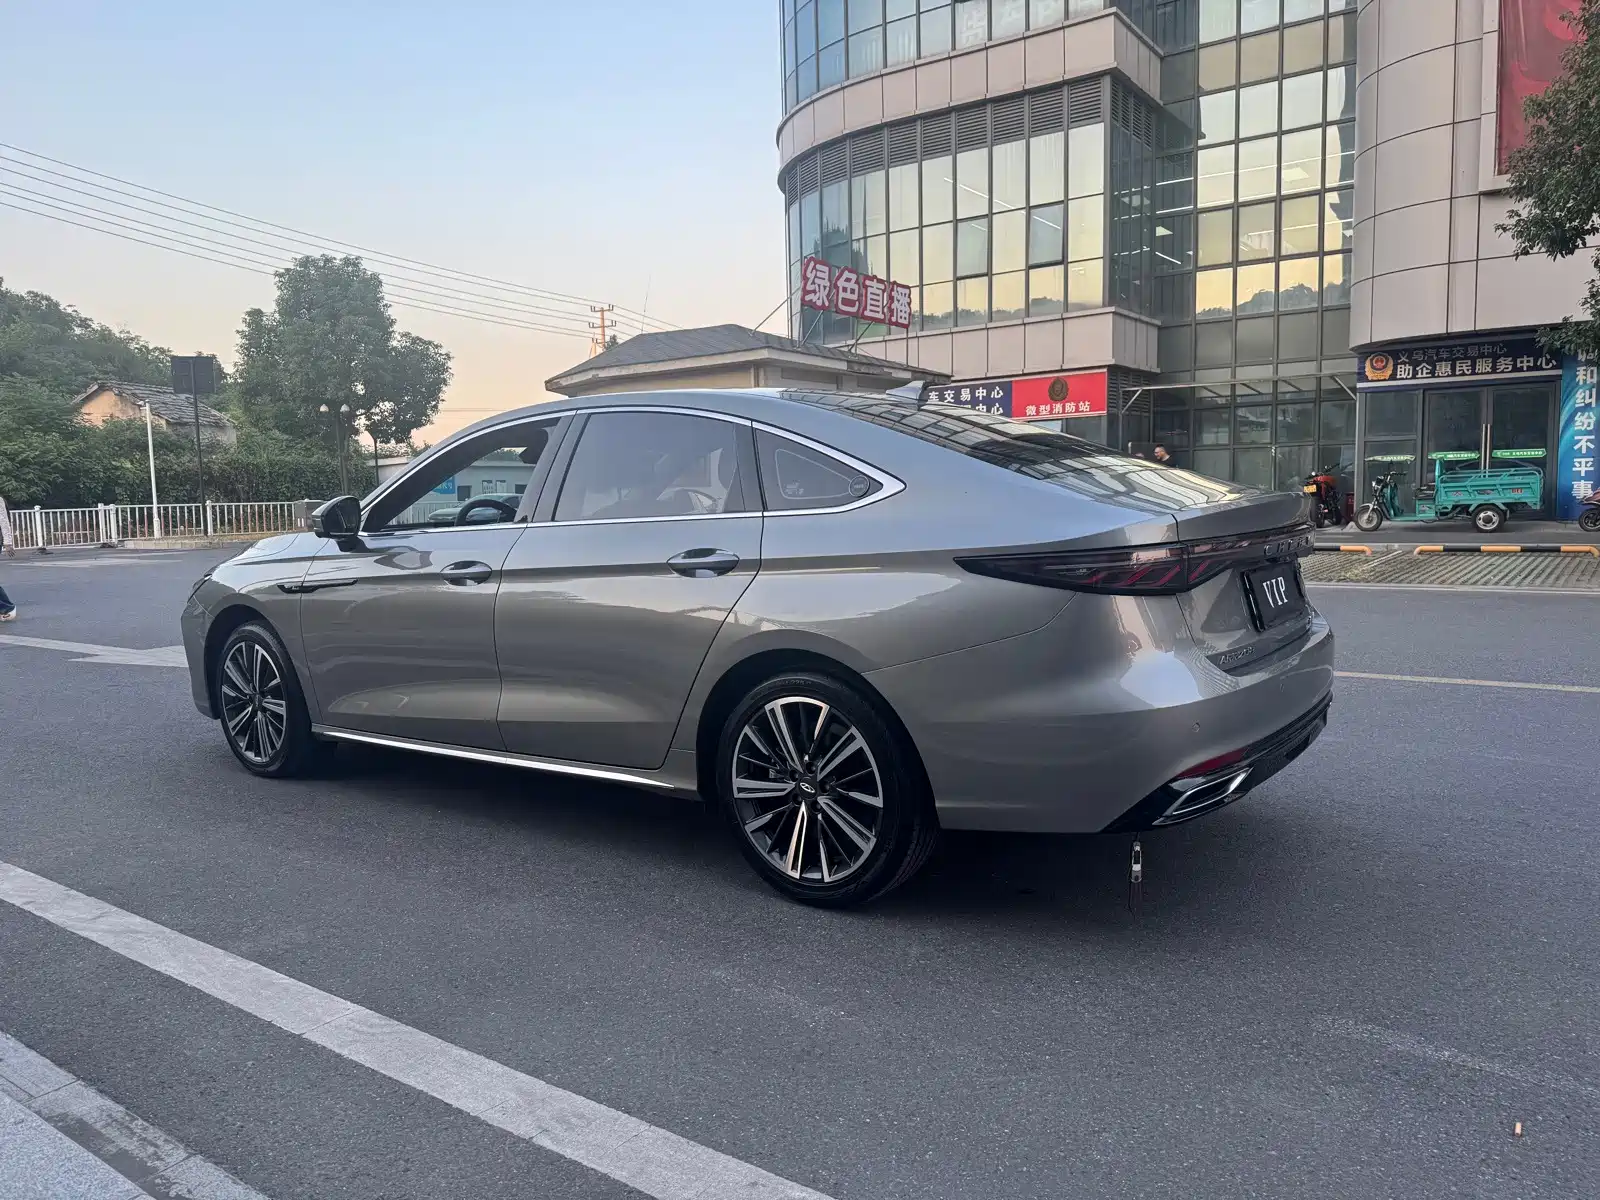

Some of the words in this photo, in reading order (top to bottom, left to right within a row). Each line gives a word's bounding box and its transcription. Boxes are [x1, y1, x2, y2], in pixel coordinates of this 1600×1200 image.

[804, 260, 910, 324] 绿色直播
[1396, 353, 1557, 379] 助企惠民服务中心
[1397, 343, 1508, 363] 义乌汽车交易中心
[1025, 401, 1091, 416] 微型消防站
[1262, 576, 1289, 608] VIP
